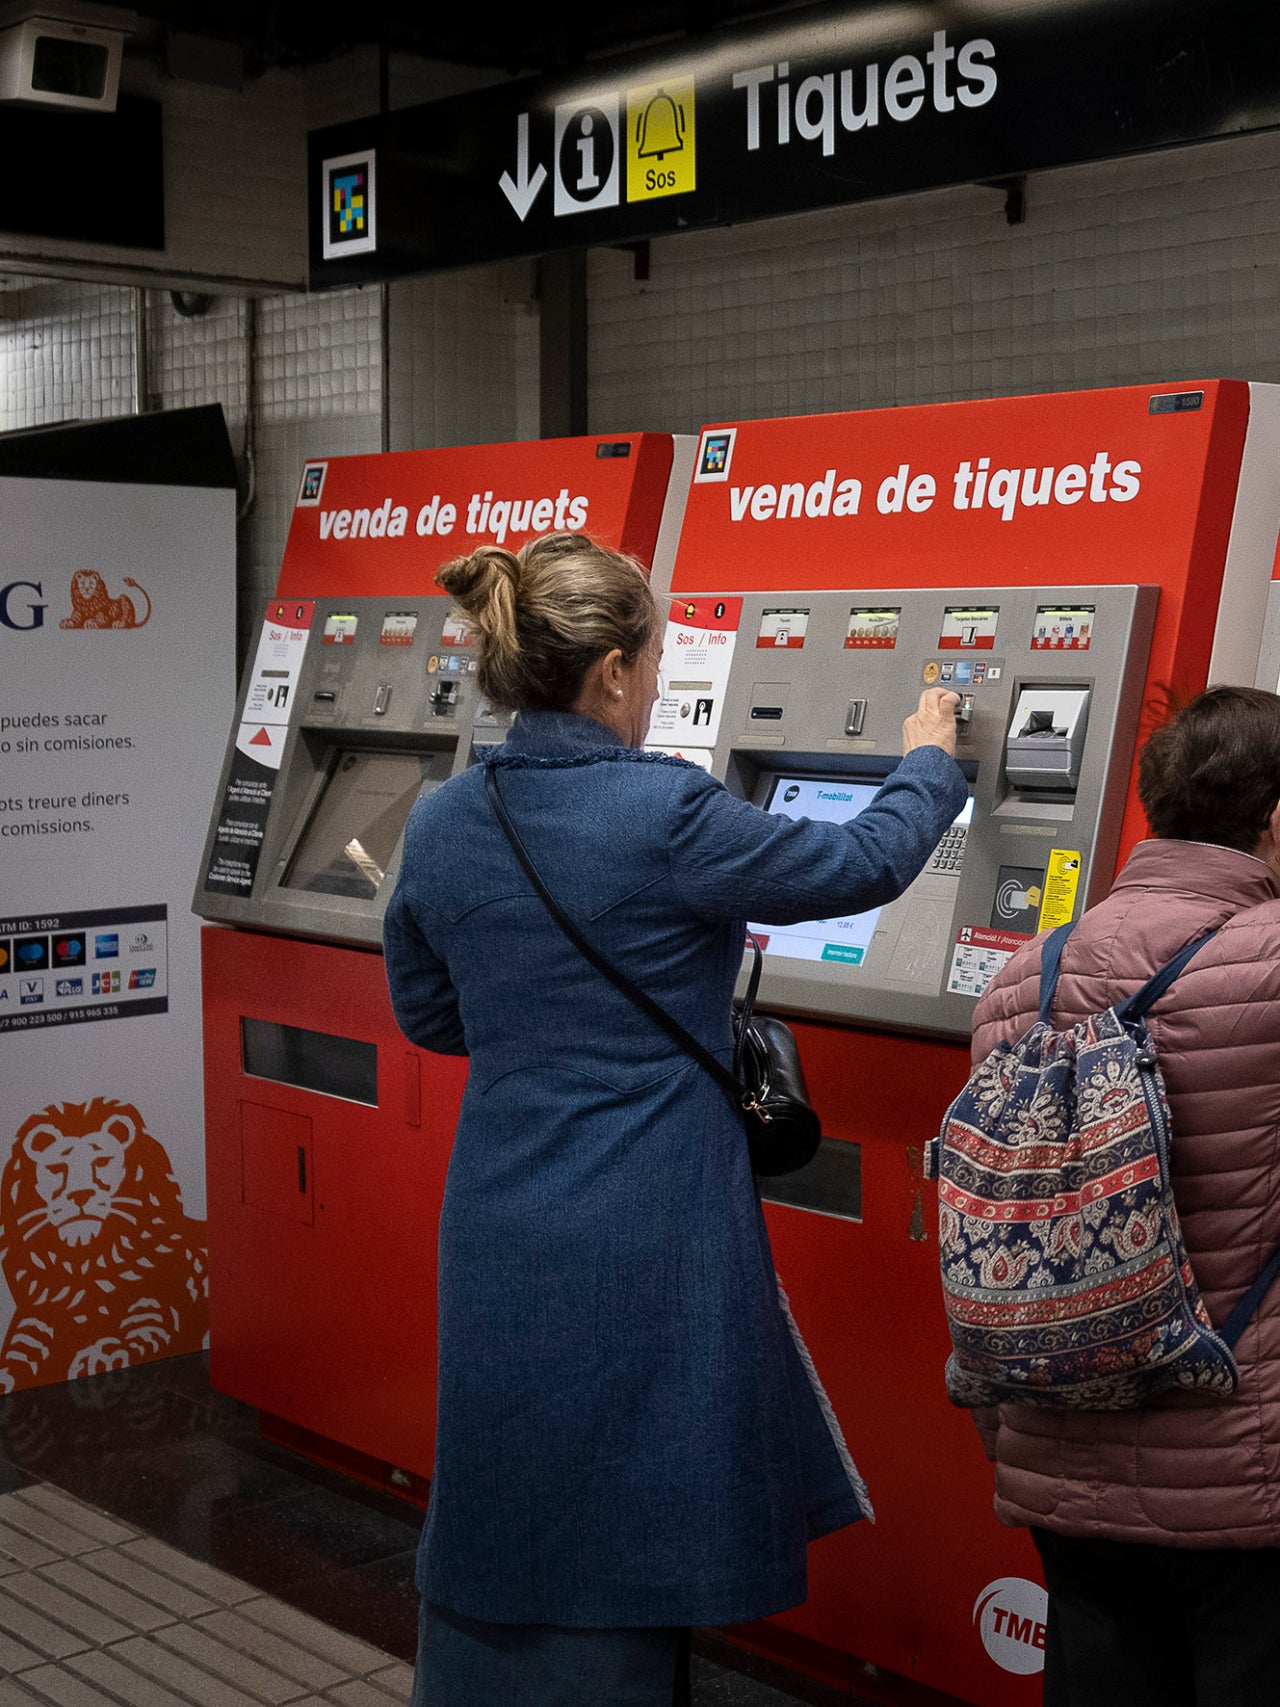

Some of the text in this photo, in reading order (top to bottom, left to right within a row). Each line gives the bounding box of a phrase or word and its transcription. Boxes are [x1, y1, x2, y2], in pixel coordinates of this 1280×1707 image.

[732, 30, 998, 156] Tiquets
[645, 169, 676, 191] Sos
[730, 451, 1143, 521] venda de tiquets
[319, 488, 589, 543] venda de tiquets
[269, 630, 281, 641] Sos
[676, 633, 694, 645] Sos
[708, 633, 727, 645] Info
[1, 712, 108, 732] puedes sacar
[17, 737, 39, 752] sin
[44, 734, 136, 751] comisiones.
[28, 794, 77, 810] treure
[81, 791, 130, 807] diners
[1, 818, 94, 836] comissions.
[0, 922, 17, 933] TM
[35, 919, 60, 930] 1592
[993, 1606, 1047, 1652] TMB
